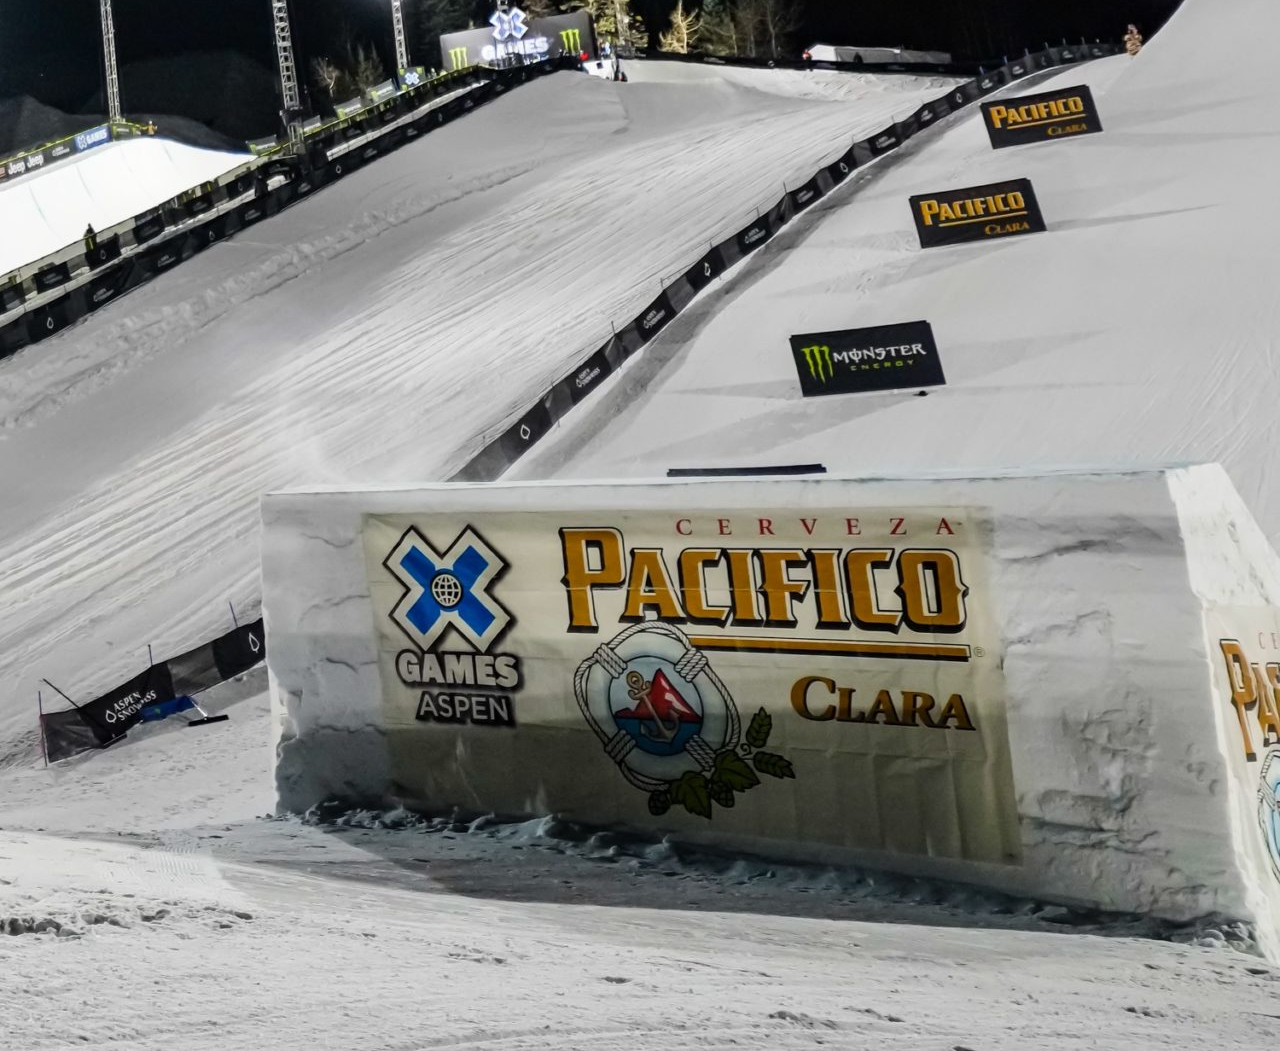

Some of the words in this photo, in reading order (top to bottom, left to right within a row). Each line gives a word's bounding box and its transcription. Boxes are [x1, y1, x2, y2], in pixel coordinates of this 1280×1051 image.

[989, 96, 1084, 129] PACIFICO
[1047, 122, 1088, 136] CLARA
[920, 191, 1025, 226] PACIFICO
[984, 220, 1030, 236] CLARA
[832, 343, 927, 364] MONSTER
[850, 359, 915, 372] ENERGY
[676, 518, 955, 536] CERVEZA
[559, 526, 970, 635] PACIFICO
[395, 649, 524, 692] GAMES
[113, 691, 142, 713] ASPEN
[418, 692, 510, 722] ASPEN
[790, 675, 977, 731] CLARA
